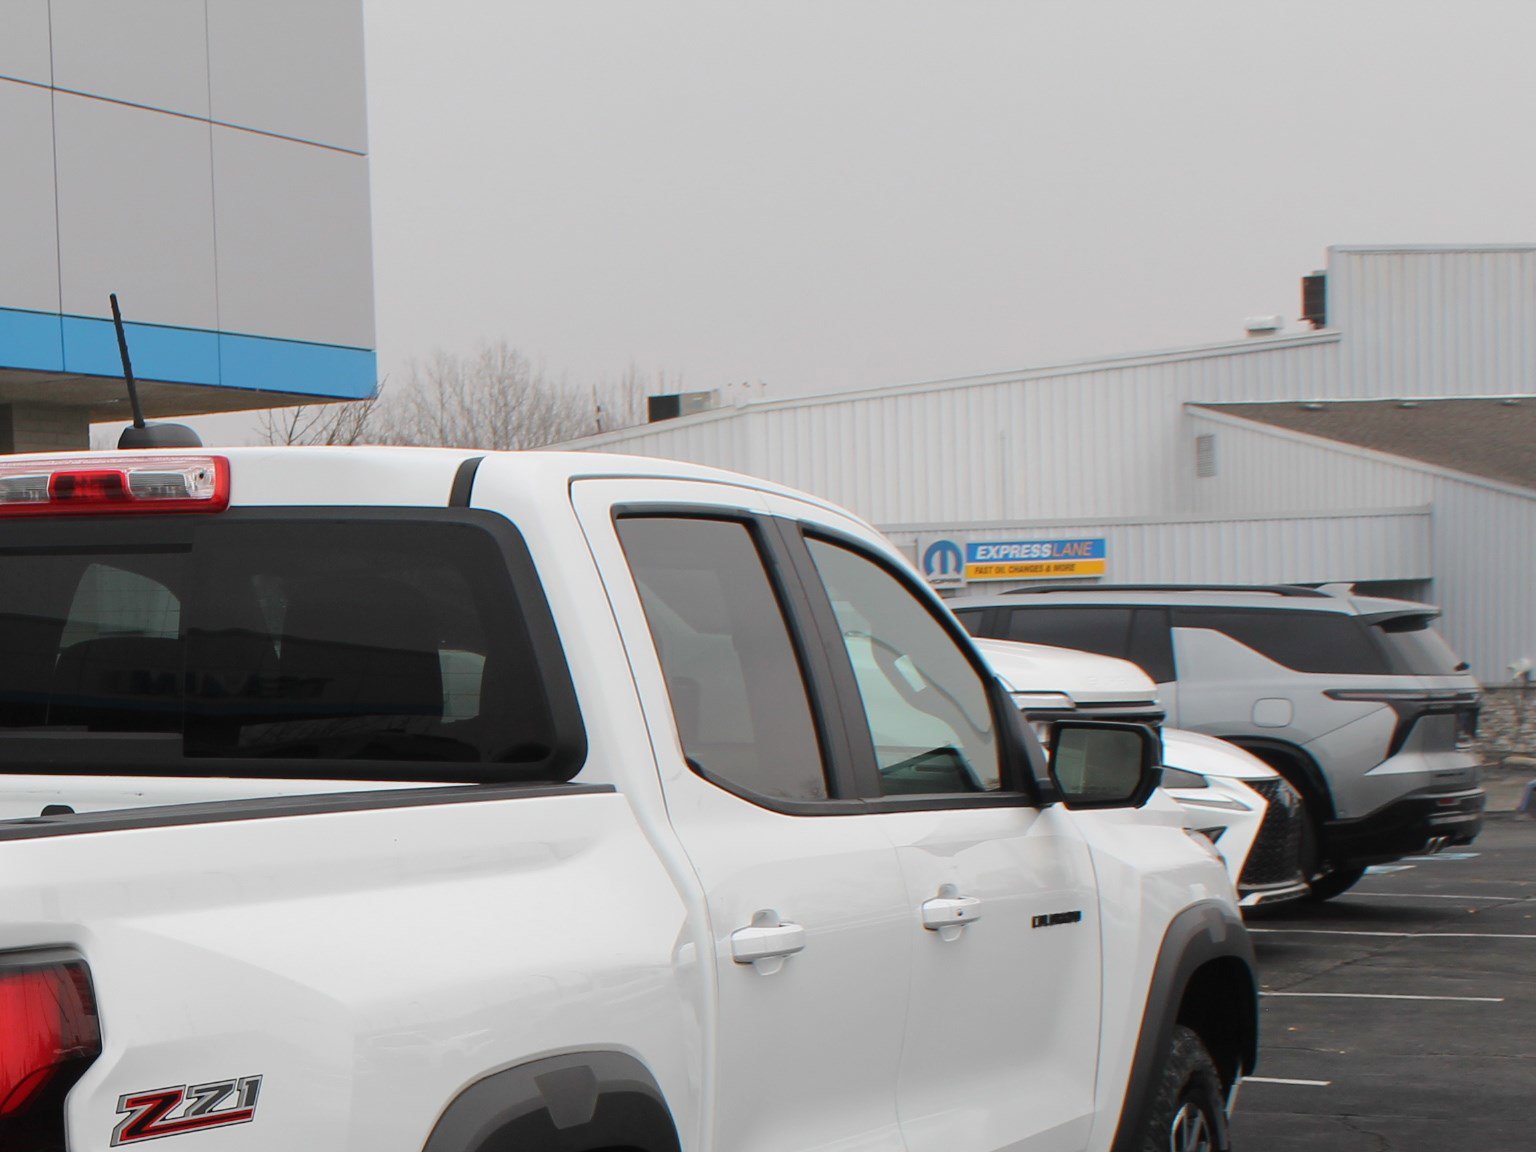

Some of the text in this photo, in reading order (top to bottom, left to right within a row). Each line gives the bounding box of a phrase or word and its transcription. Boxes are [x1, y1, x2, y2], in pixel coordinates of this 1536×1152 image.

[975, 566, 993, 574] FAST
[995, 566, 1005, 574] OIL
[1009, 564, 1044, 574] CHANGES
[1053, 563, 1076, 572] MORE
[109, 1074, 264, 1148] Z71
